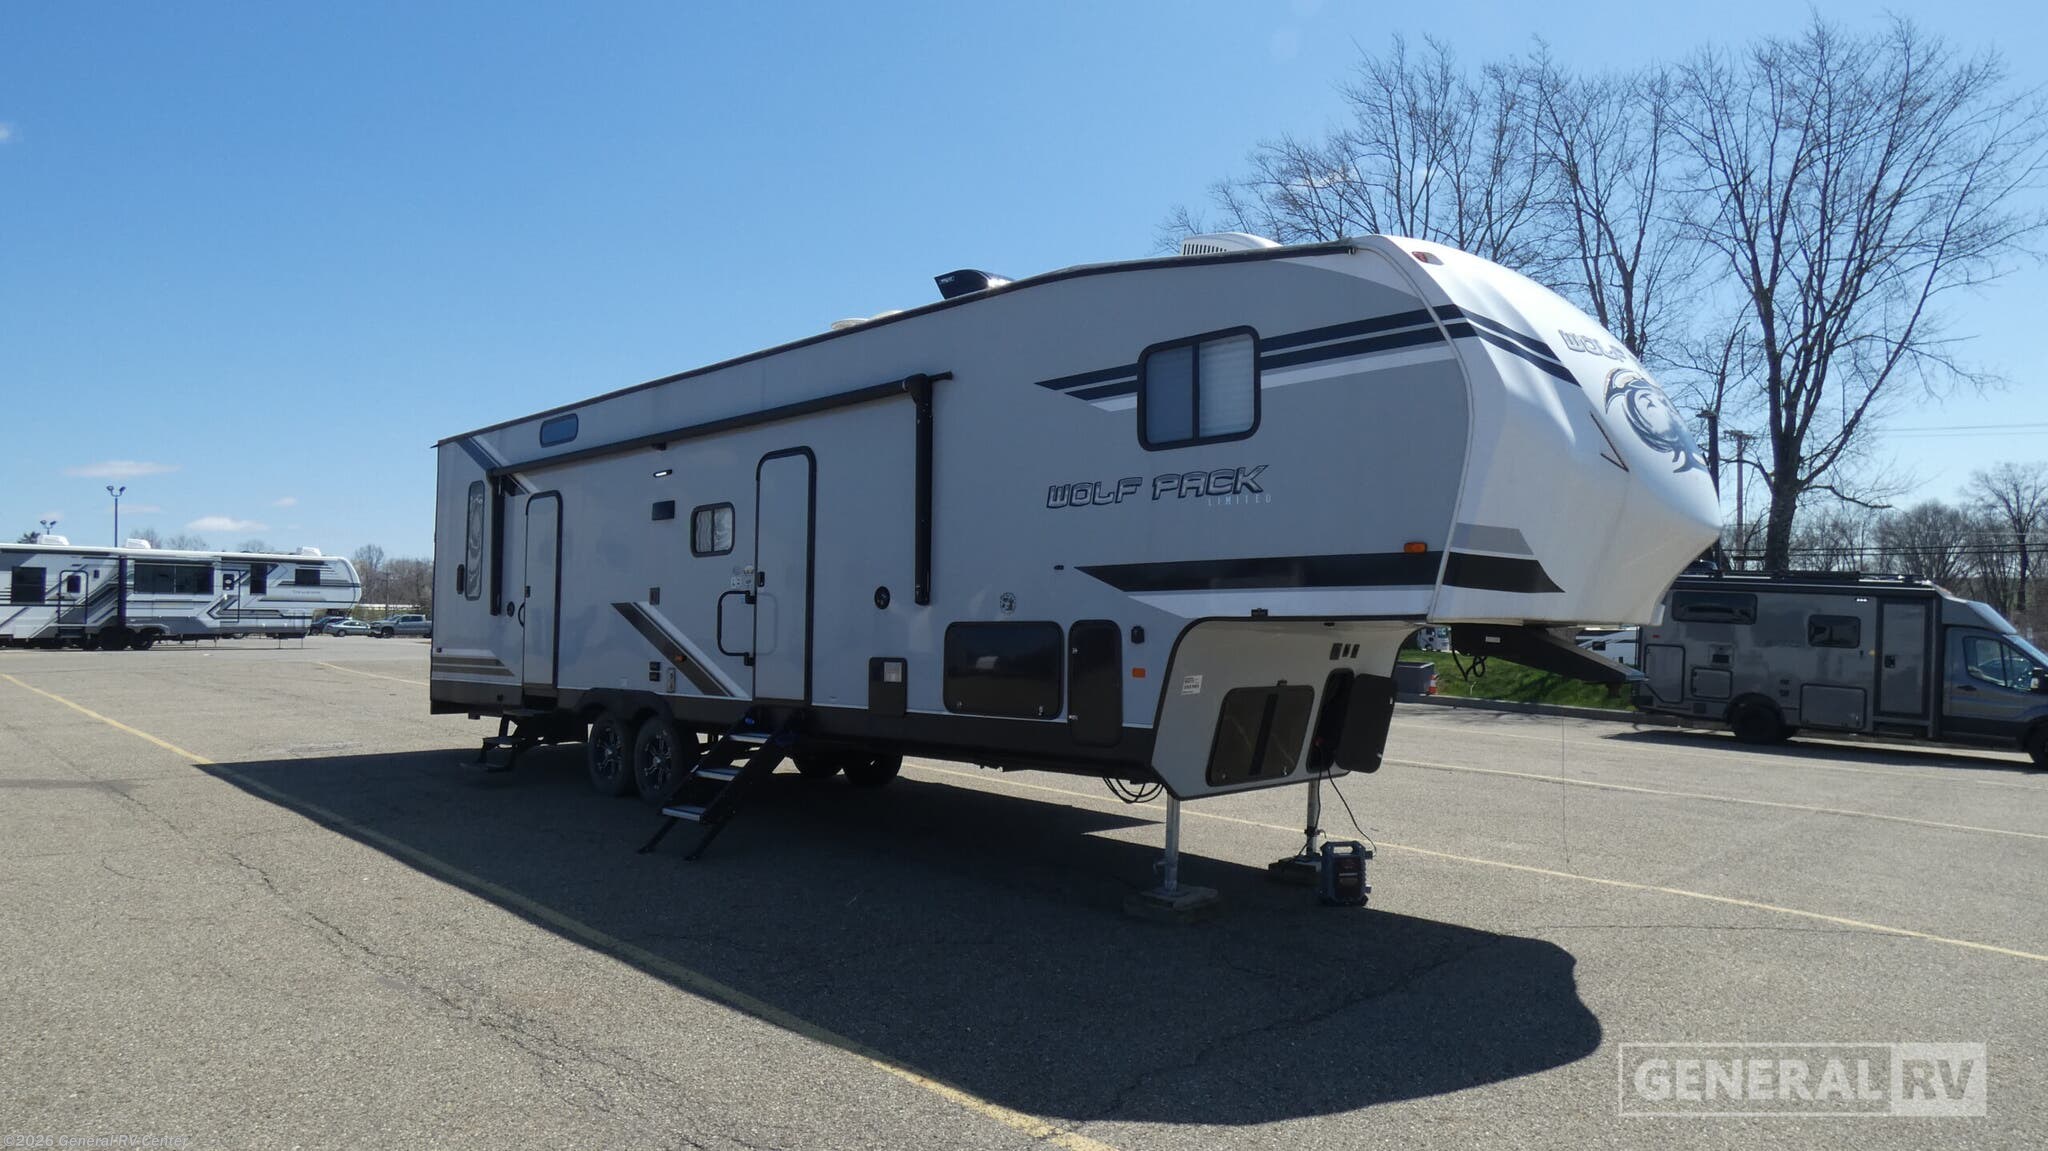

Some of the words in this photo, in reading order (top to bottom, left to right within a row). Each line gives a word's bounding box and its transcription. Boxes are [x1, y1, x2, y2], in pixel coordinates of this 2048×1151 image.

[1046, 476, 1143, 509] WOLF
[1152, 464, 1269, 500] PACK
[1208, 494, 1273, 506] LIMITED
